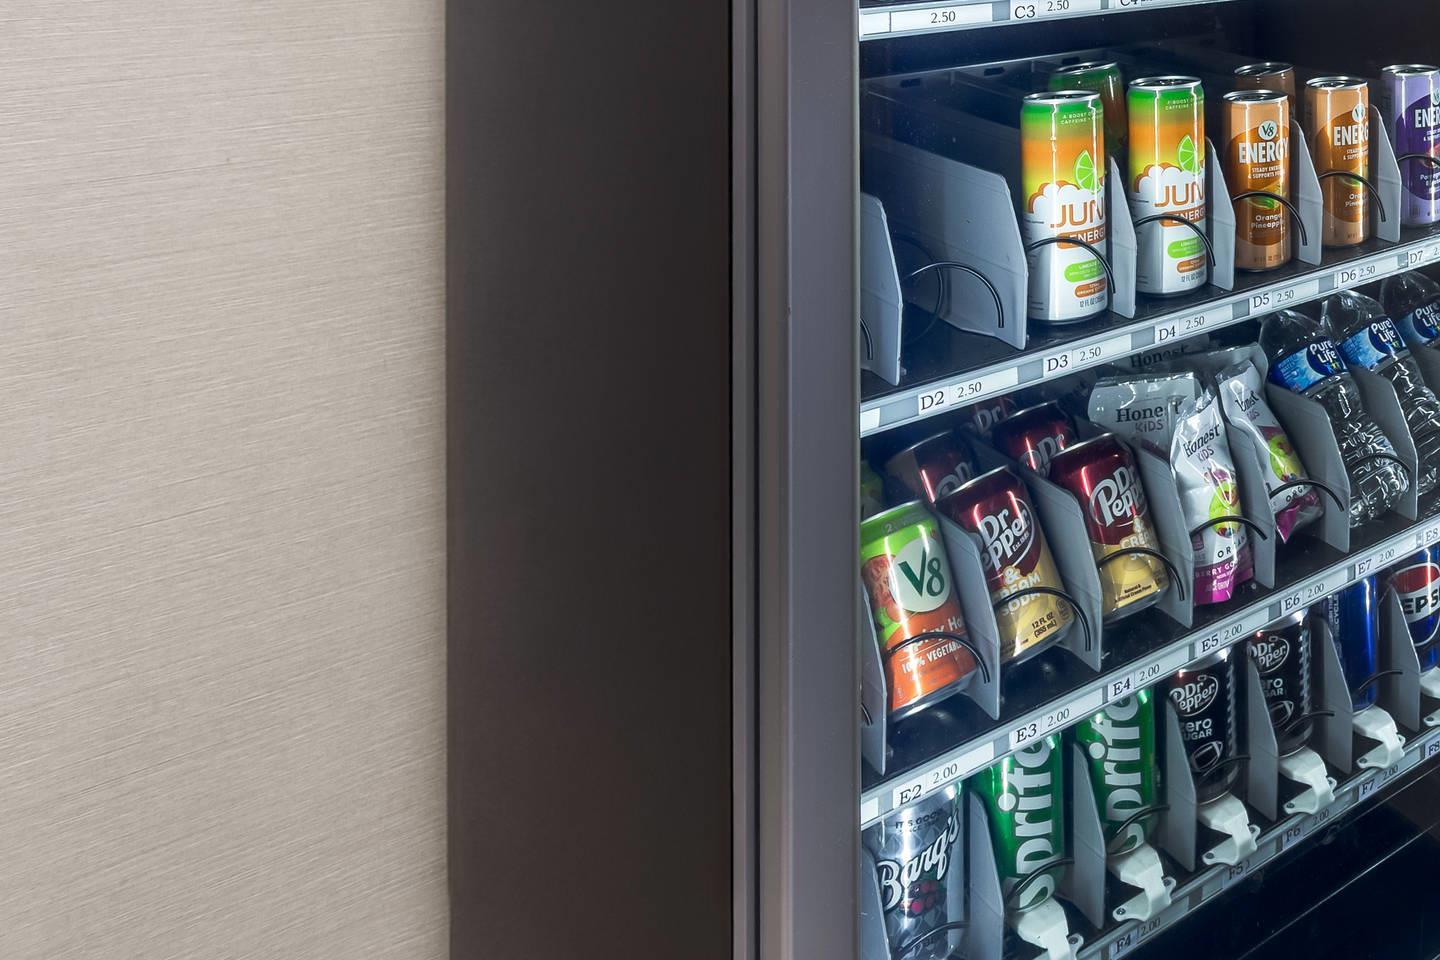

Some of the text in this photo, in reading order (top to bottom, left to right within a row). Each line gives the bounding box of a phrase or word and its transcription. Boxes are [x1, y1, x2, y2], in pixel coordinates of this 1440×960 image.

[931, 10, 956, 24] 2.50
[1014, 0, 1070, 20] C3 2.50
[1261, 122, 1275, 138] V8
[1238, 137, 1289, 164] ENERGY
[1409, 250, 1424, 264] D7
[1340, 265, 1376, 282] D6 2.50
[1252, 289, 1295, 308] D5 2.50
[1415, 301, 1440, 320] Pure
[1158, 315, 1205, 342] D4 2.50
[1370, 318, 1392, 335] Pure
[1378, 327, 1396, 343] Life
[1047, 346, 1102, 372] D3 2.50
[1129, 343, 1190, 369] Honest
[1310, 340, 1334, 356] Pure
[1317, 349, 1338, 364] Life
[920, 381, 982, 411] D2 2.50
[1115, 401, 1182, 423] Honet
[1182, 423, 1220, 458] Honest
[979, 507, 1010, 548] Dr
[1425, 527, 1439, 542] E8
[897, 545, 946, 598] V8
[1357, 548, 1395, 576] E7 2.00
[1283, 582, 1325, 612] E6 2.00
[1031, 620, 1039, 630] 12
[1039, 617, 1047, 626] FL
[1033, 625, 1047, 639] (355
[1201, 624, 1243, 653] E5 2.00
[1256, 641, 1275, 658] Dr
[1111, 664, 1160, 697] E4 2.00
[1184, 681, 1205, 700] Dr
[1016, 708, 1070, 744] E3 2.00
[1428, 740, 1440, 756] F8
[899, 762, 958, 805] E2 2.00
[1361, 764, 1399, 796] F7 2.00
[1286, 808, 1330, 843] F6 2.00
[876, 809, 960, 911] Barq's
[1228, 862, 1244, 880] F5
[1116, 916, 1161, 953] F4 2.00
